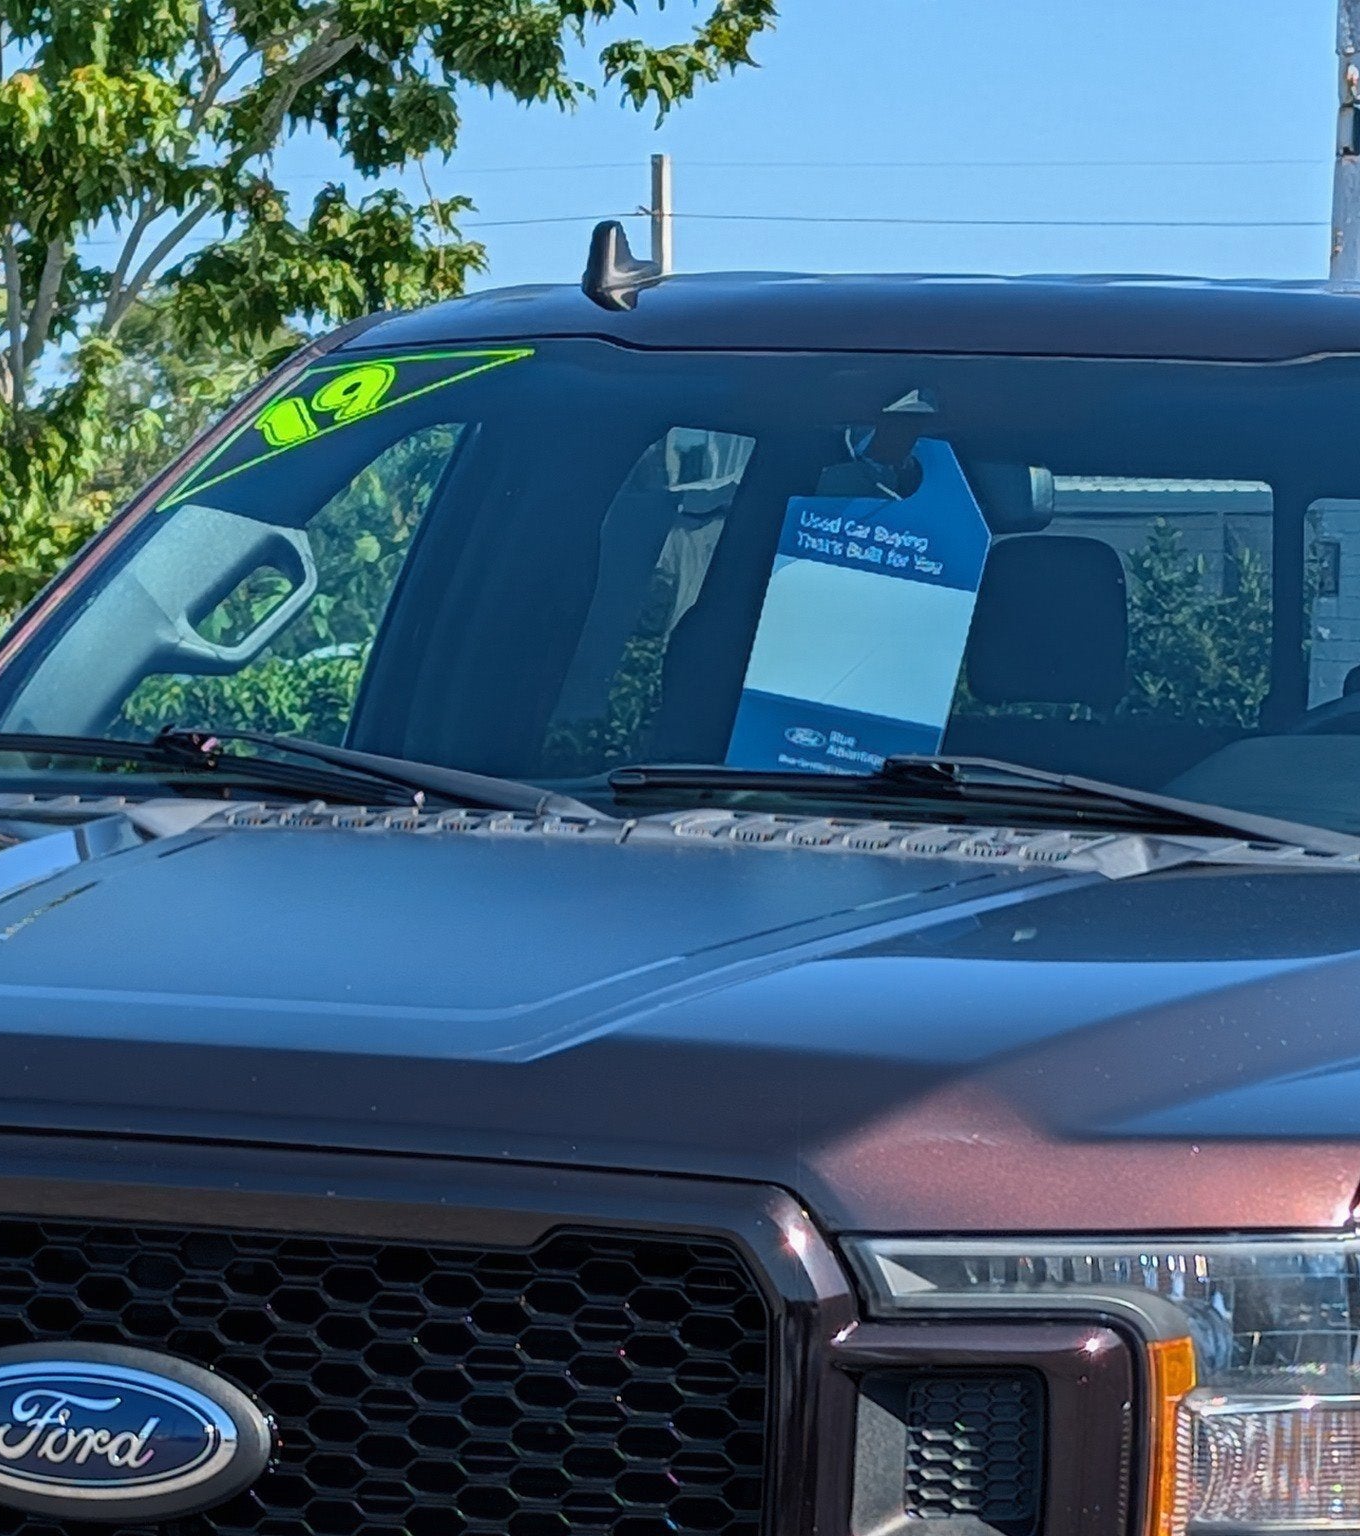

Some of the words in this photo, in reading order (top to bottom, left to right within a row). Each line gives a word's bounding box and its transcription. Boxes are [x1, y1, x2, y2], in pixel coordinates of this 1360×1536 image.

[255, 361, 396, 447] 19
[800, 510, 842, 534] Used
[844, 520, 871, 539] Car
[874, 526, 929, 553] Buying
[846, 541, 883, 563] Built
[886, 549, 910, 568] for
[913, 554, 943, 575] You
